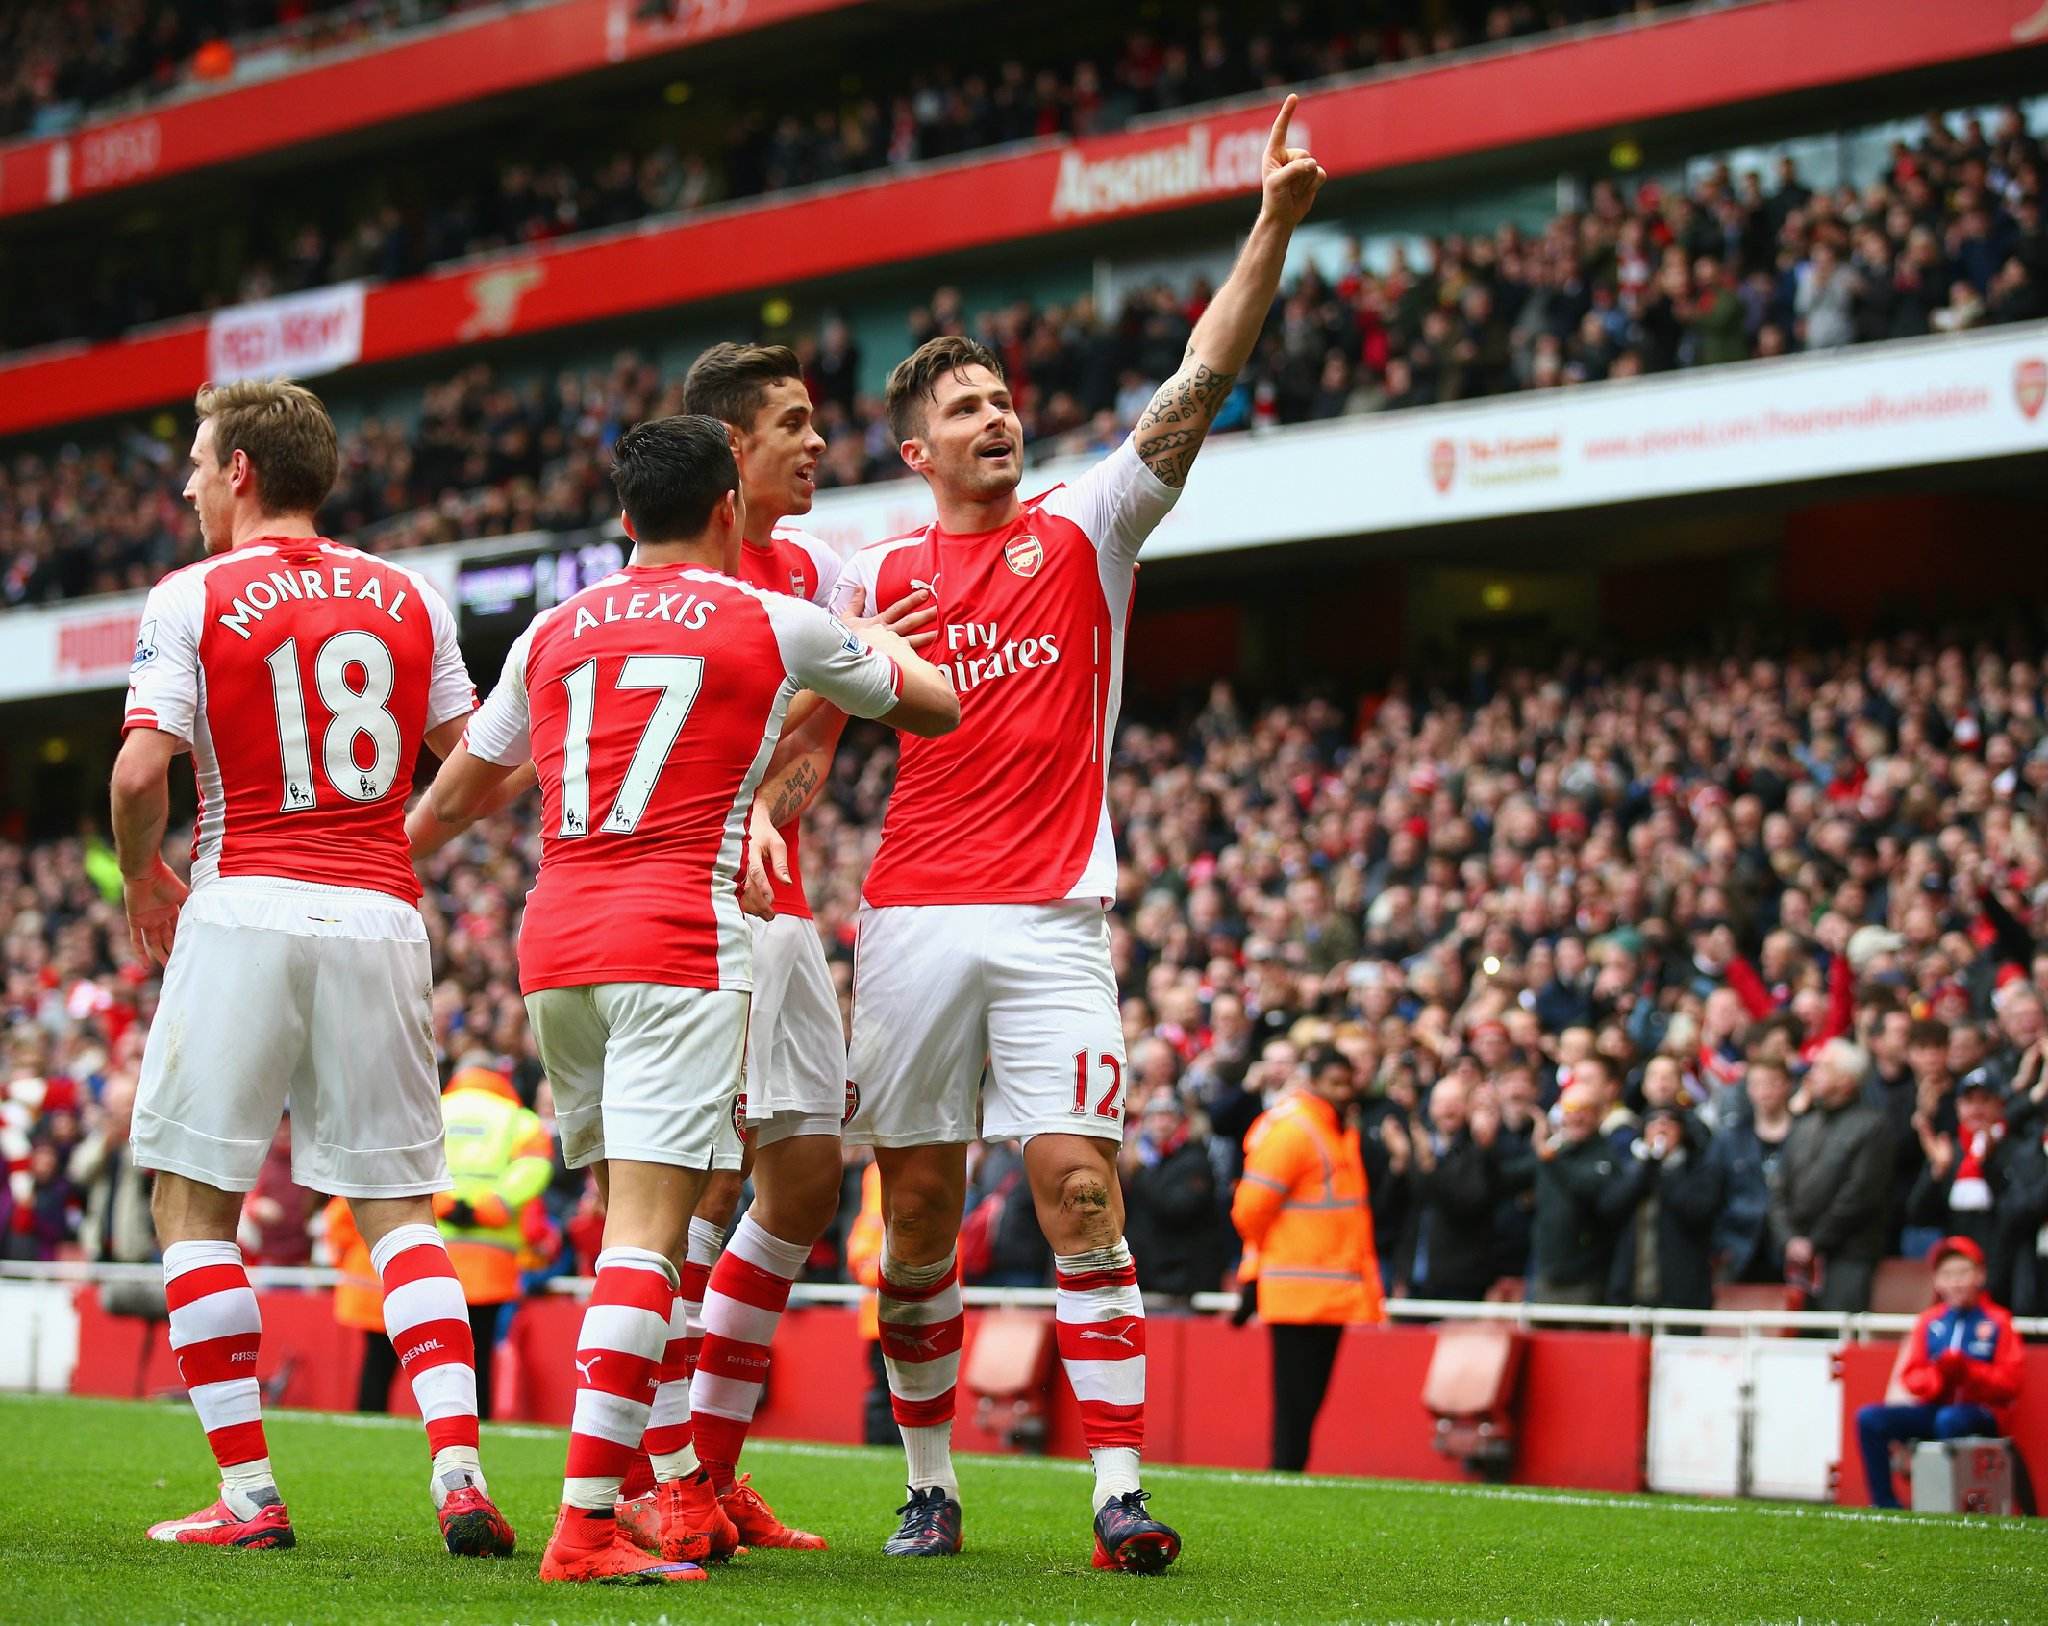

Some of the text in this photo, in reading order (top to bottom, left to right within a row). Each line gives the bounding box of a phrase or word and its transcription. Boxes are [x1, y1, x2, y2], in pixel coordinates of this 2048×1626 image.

[219, 567, 406, 640] MONREAL
[573, 592, 716, 639] ALEXIS
[946, 621, 998, 651] Fly
[935, 633, 1061, 692] irates
[265, 630, 402, 812] 18
[560, 655, 704, 837] 17
[1071, 1047, 1121, 1121] 12
